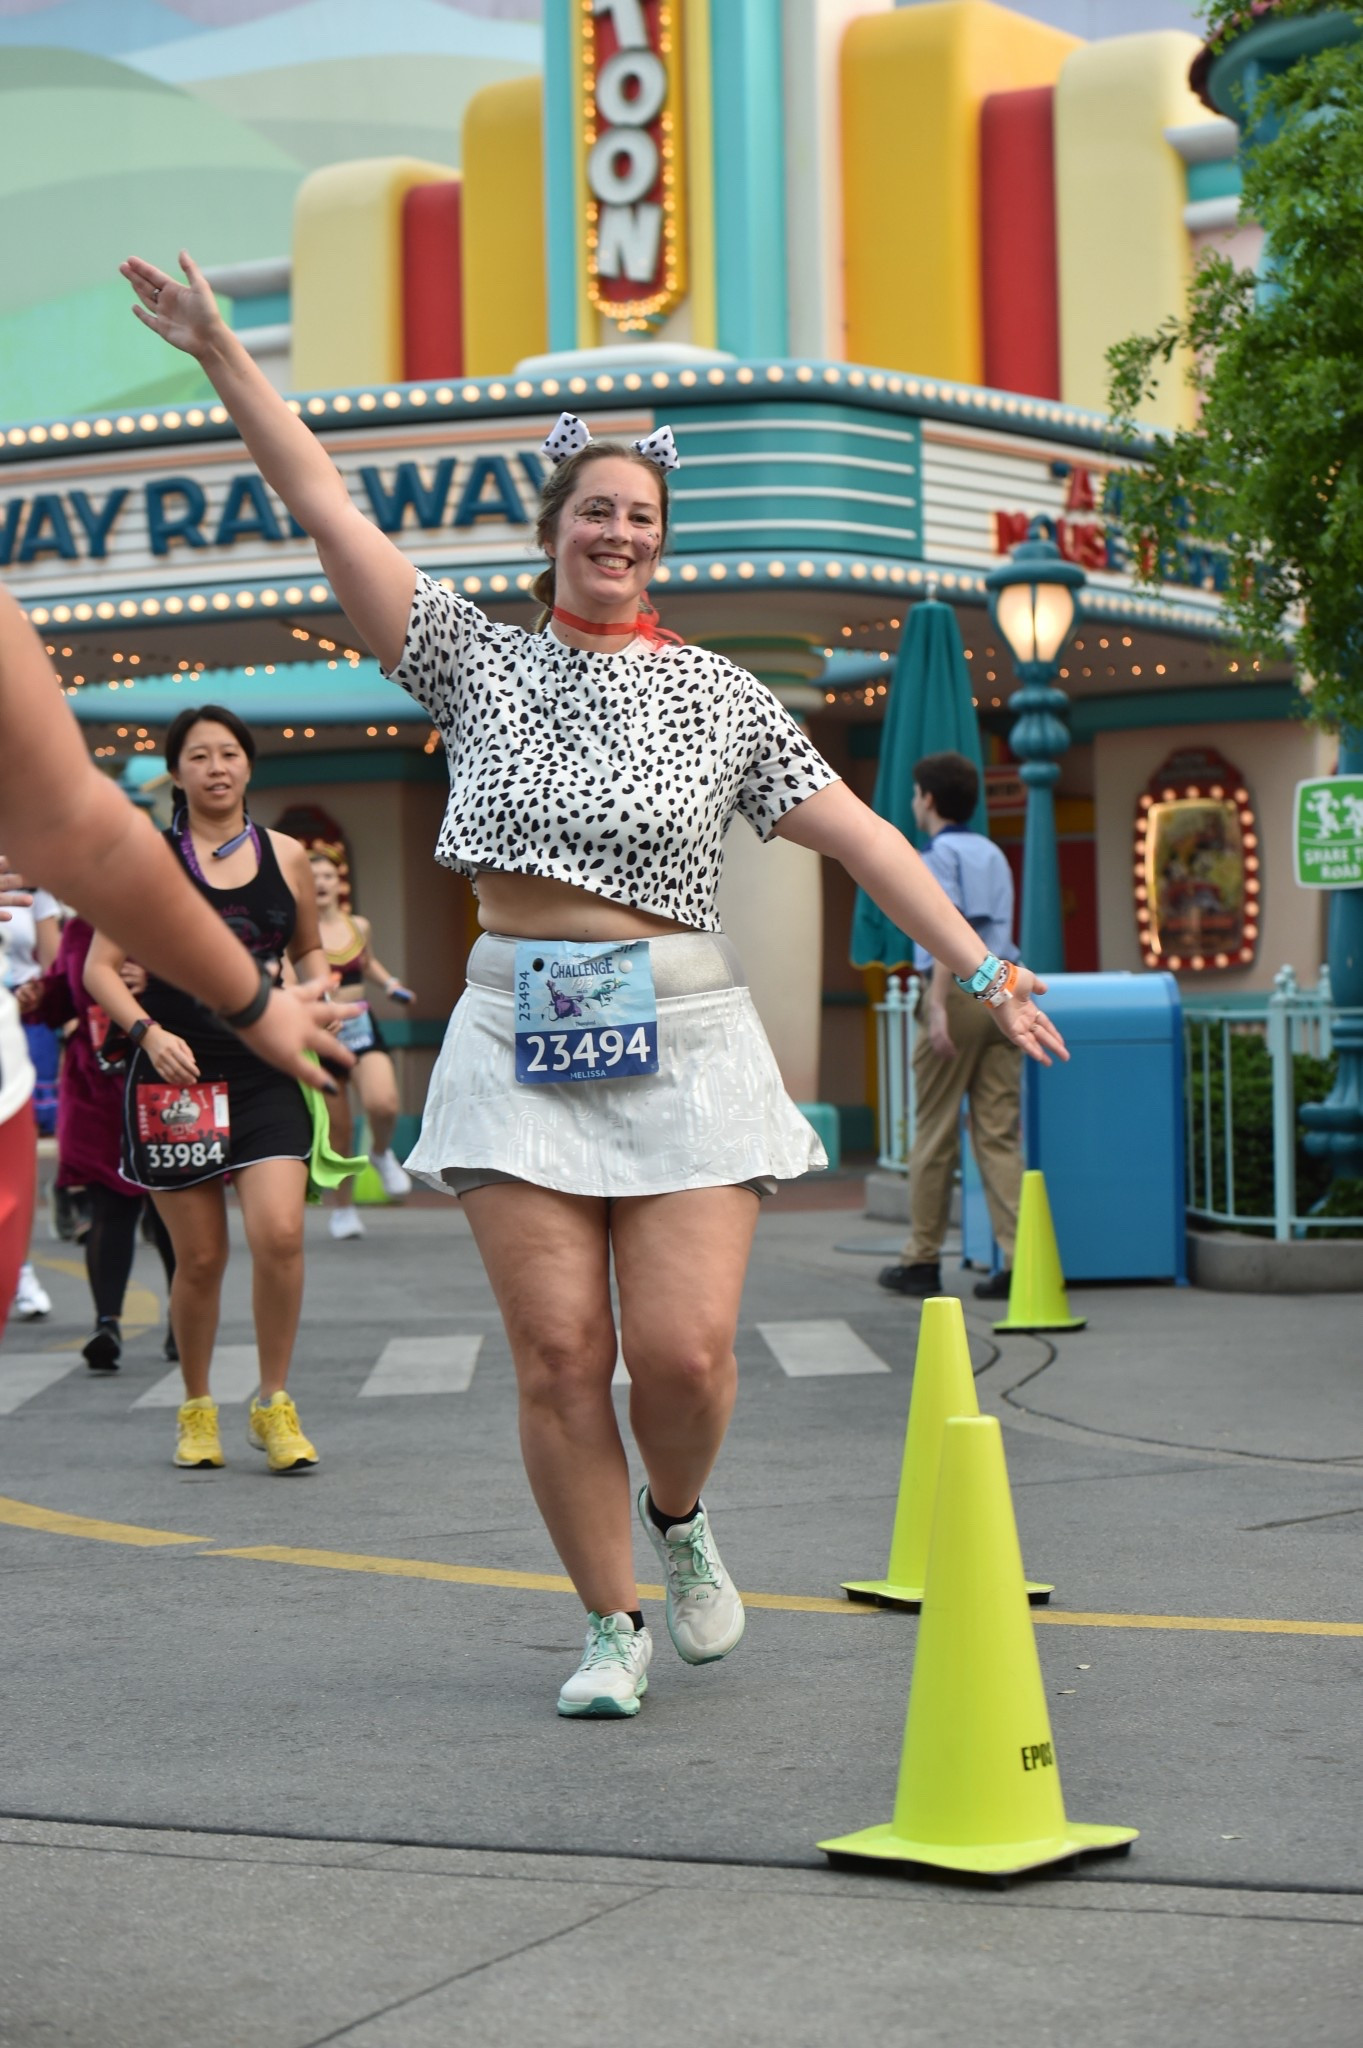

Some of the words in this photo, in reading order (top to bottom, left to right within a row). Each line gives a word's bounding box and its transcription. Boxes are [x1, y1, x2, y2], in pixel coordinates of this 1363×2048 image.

[145, 451, 547, 555] RAWA
[1320, 863, 1362, 880] ROAD
[550, 956, 615, 979] CHALLENGE
[518, 970, 531, 1021] 23494
[526, 1026, 651, 1072] 23494
[570, 1069, 607, 1080] MELISSA
[146, 1141, 225, 1169] 33984
